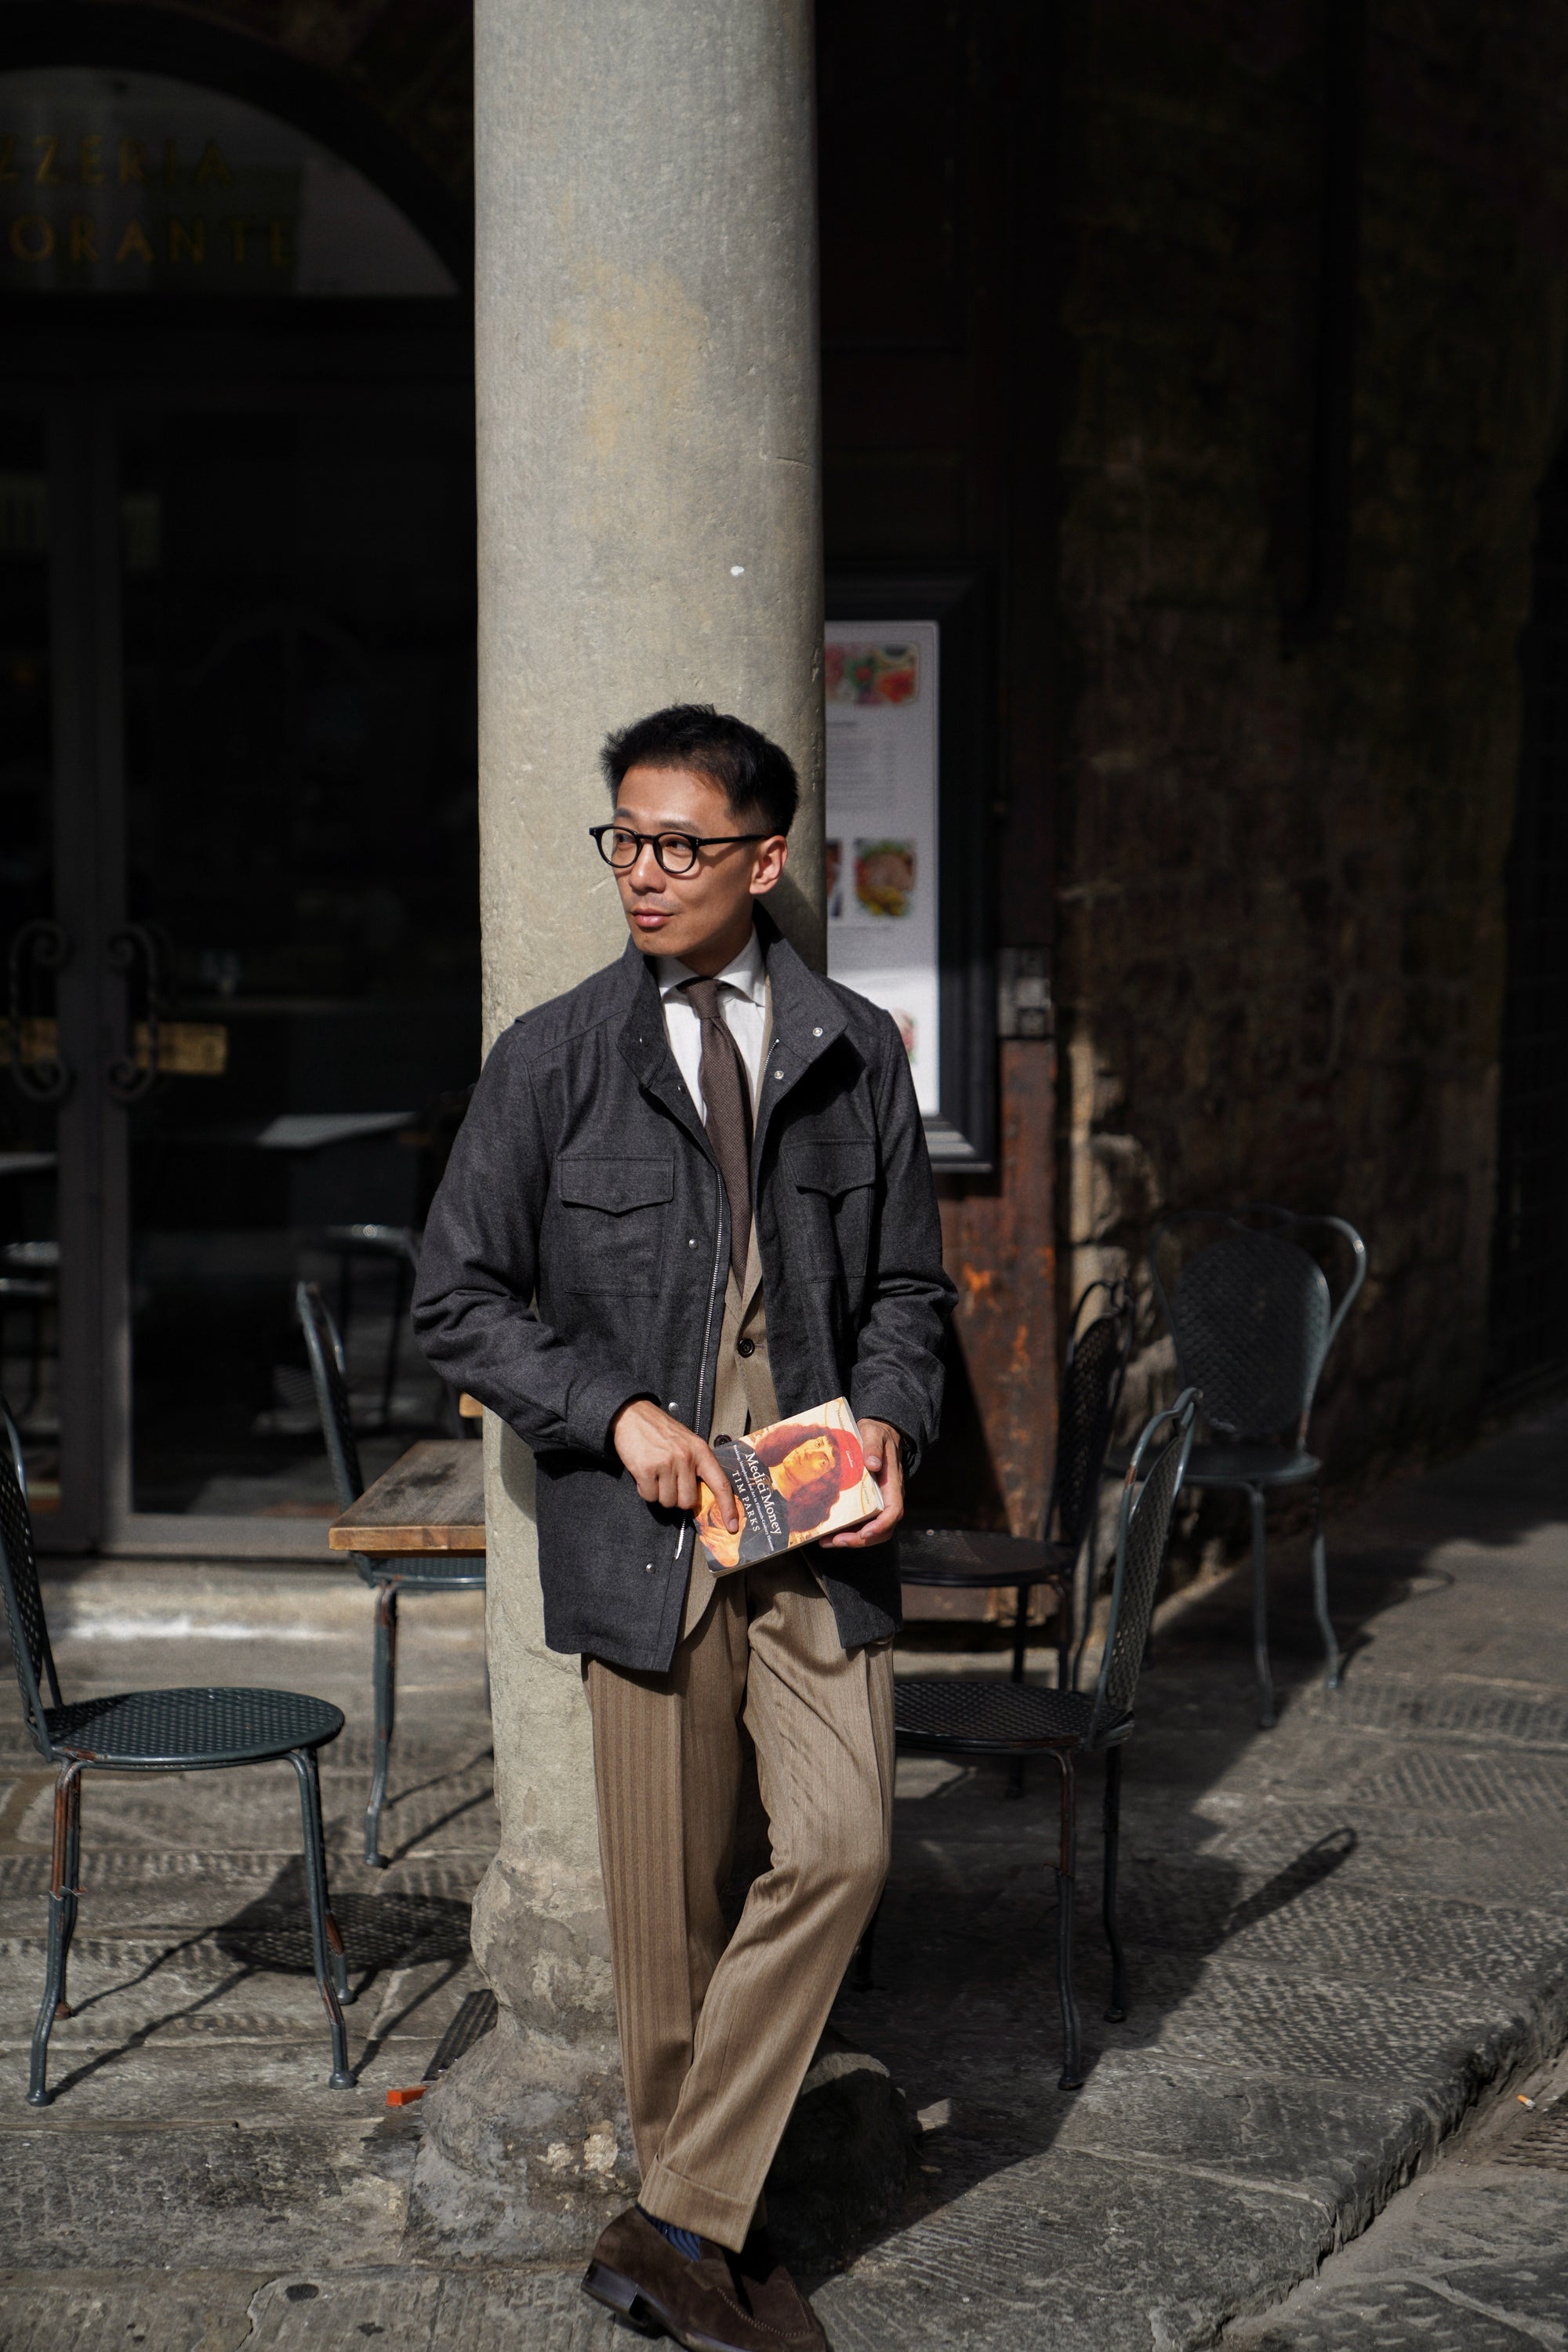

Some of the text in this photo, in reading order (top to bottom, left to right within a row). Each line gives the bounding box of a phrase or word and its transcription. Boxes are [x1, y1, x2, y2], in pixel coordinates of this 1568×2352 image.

[9, 212, 294, 266] ORANTE
[731, 1470, 760, 1532] TIM PARKS
[745, 1451, 782, 1535] Medici Money
